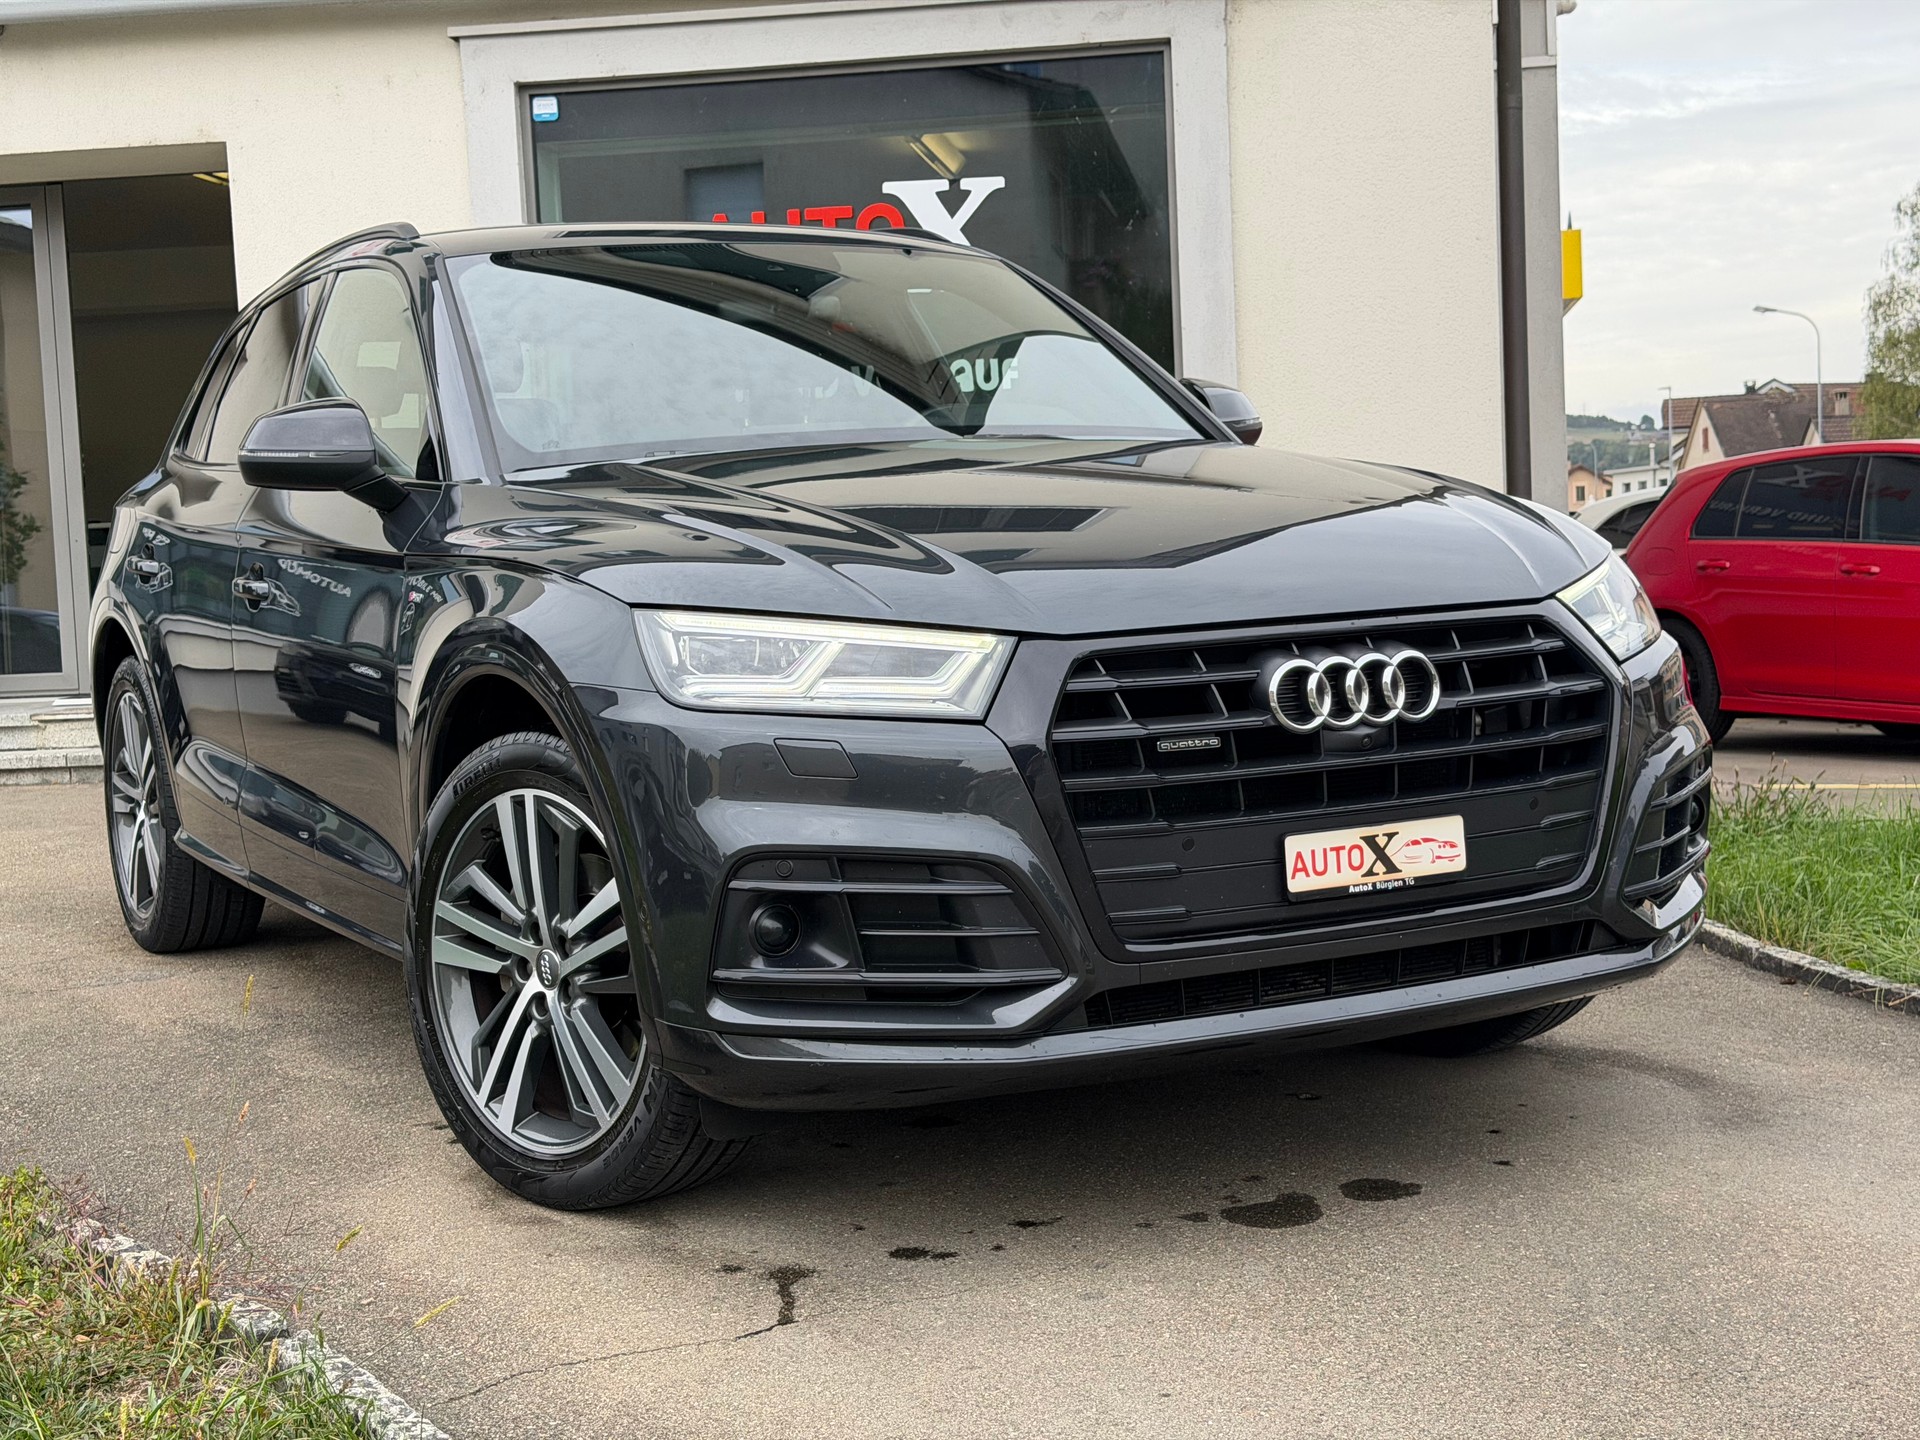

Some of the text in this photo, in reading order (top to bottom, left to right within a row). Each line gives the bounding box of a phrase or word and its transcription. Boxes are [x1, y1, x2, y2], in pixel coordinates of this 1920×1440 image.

[1160, 739, 1218, 750] quattro
[1349, 877, 1415, 893] AutoX Bürglen TG
